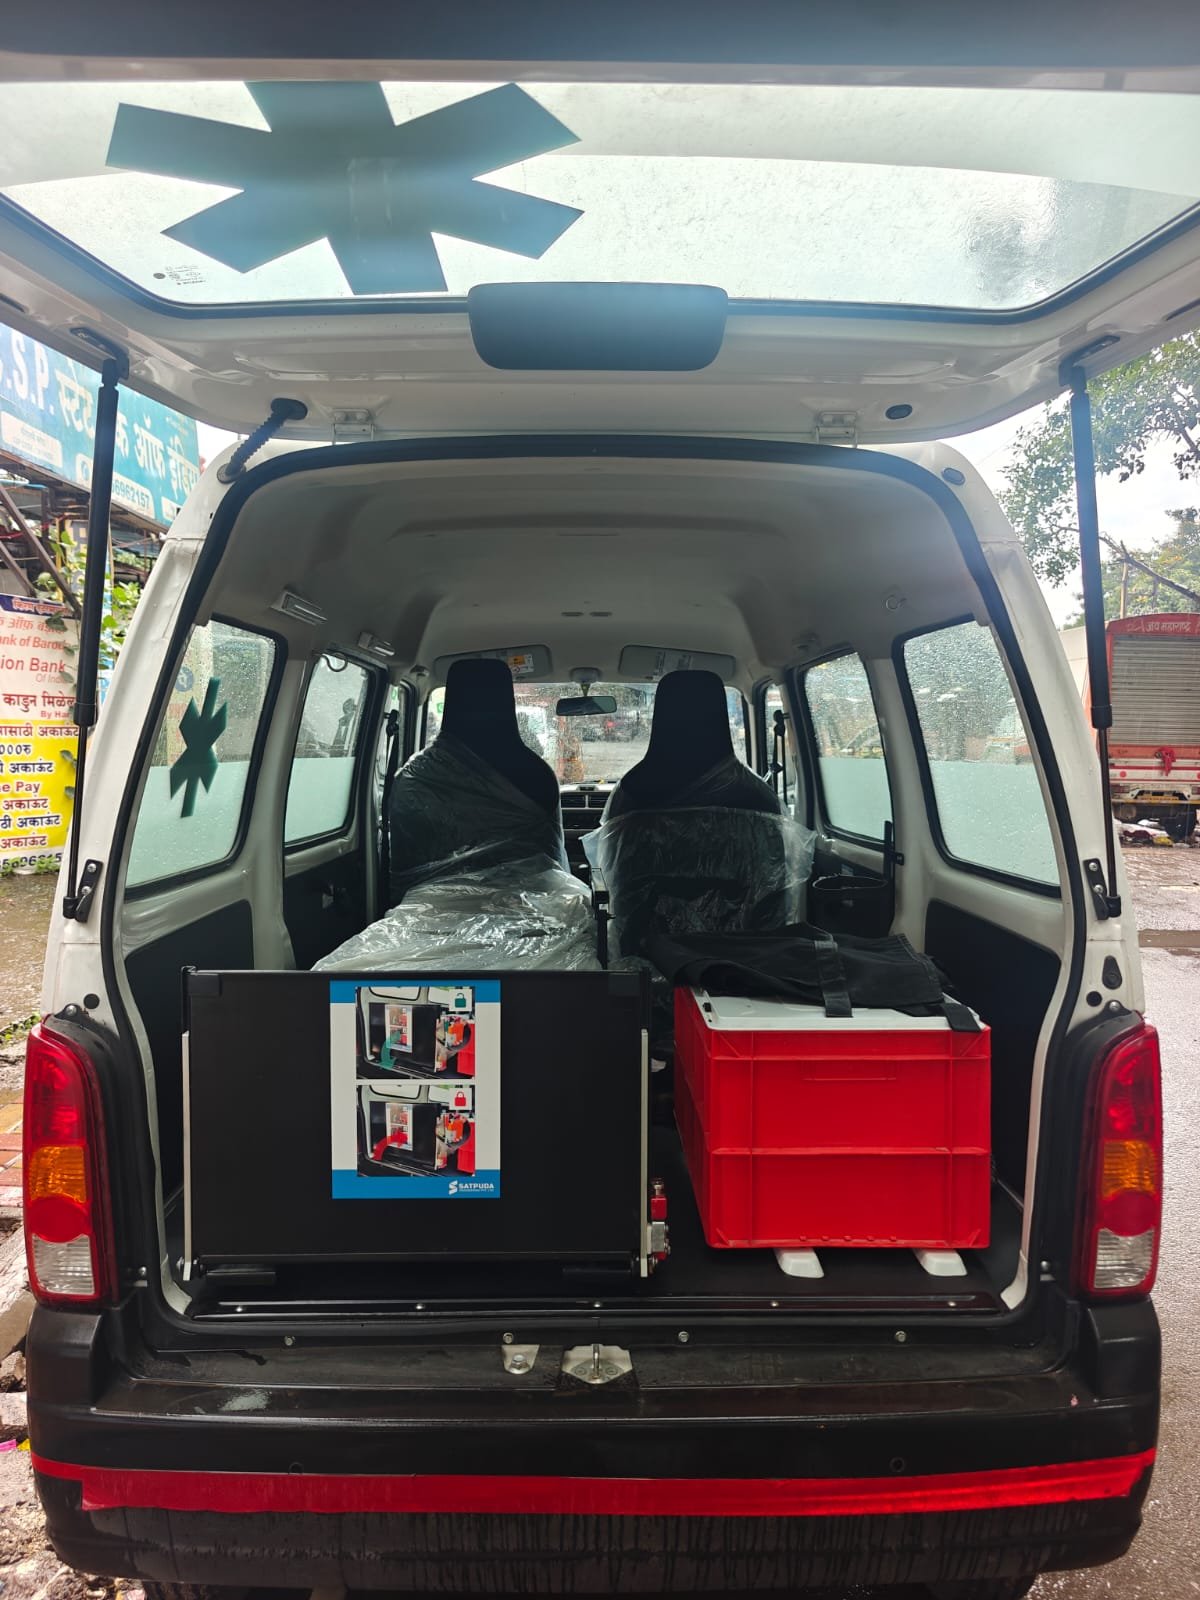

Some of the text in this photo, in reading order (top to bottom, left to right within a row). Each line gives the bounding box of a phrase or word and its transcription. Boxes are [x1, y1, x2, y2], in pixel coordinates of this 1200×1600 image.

[19, 635, 31, 647] of
[29, 657, 66, 673] Bank
[36, 673, 47, 683] Of
[40, 710, 52, 719] By
[9, 758, 54, 773] अकाऊंट
[15, 781, 41, 793] Pay
[3, 794, 49, 810] अकाऊंट
[17, 811, 61, 828] अकाऊंट
[0, 832, 48, 849] अकाऊंट
